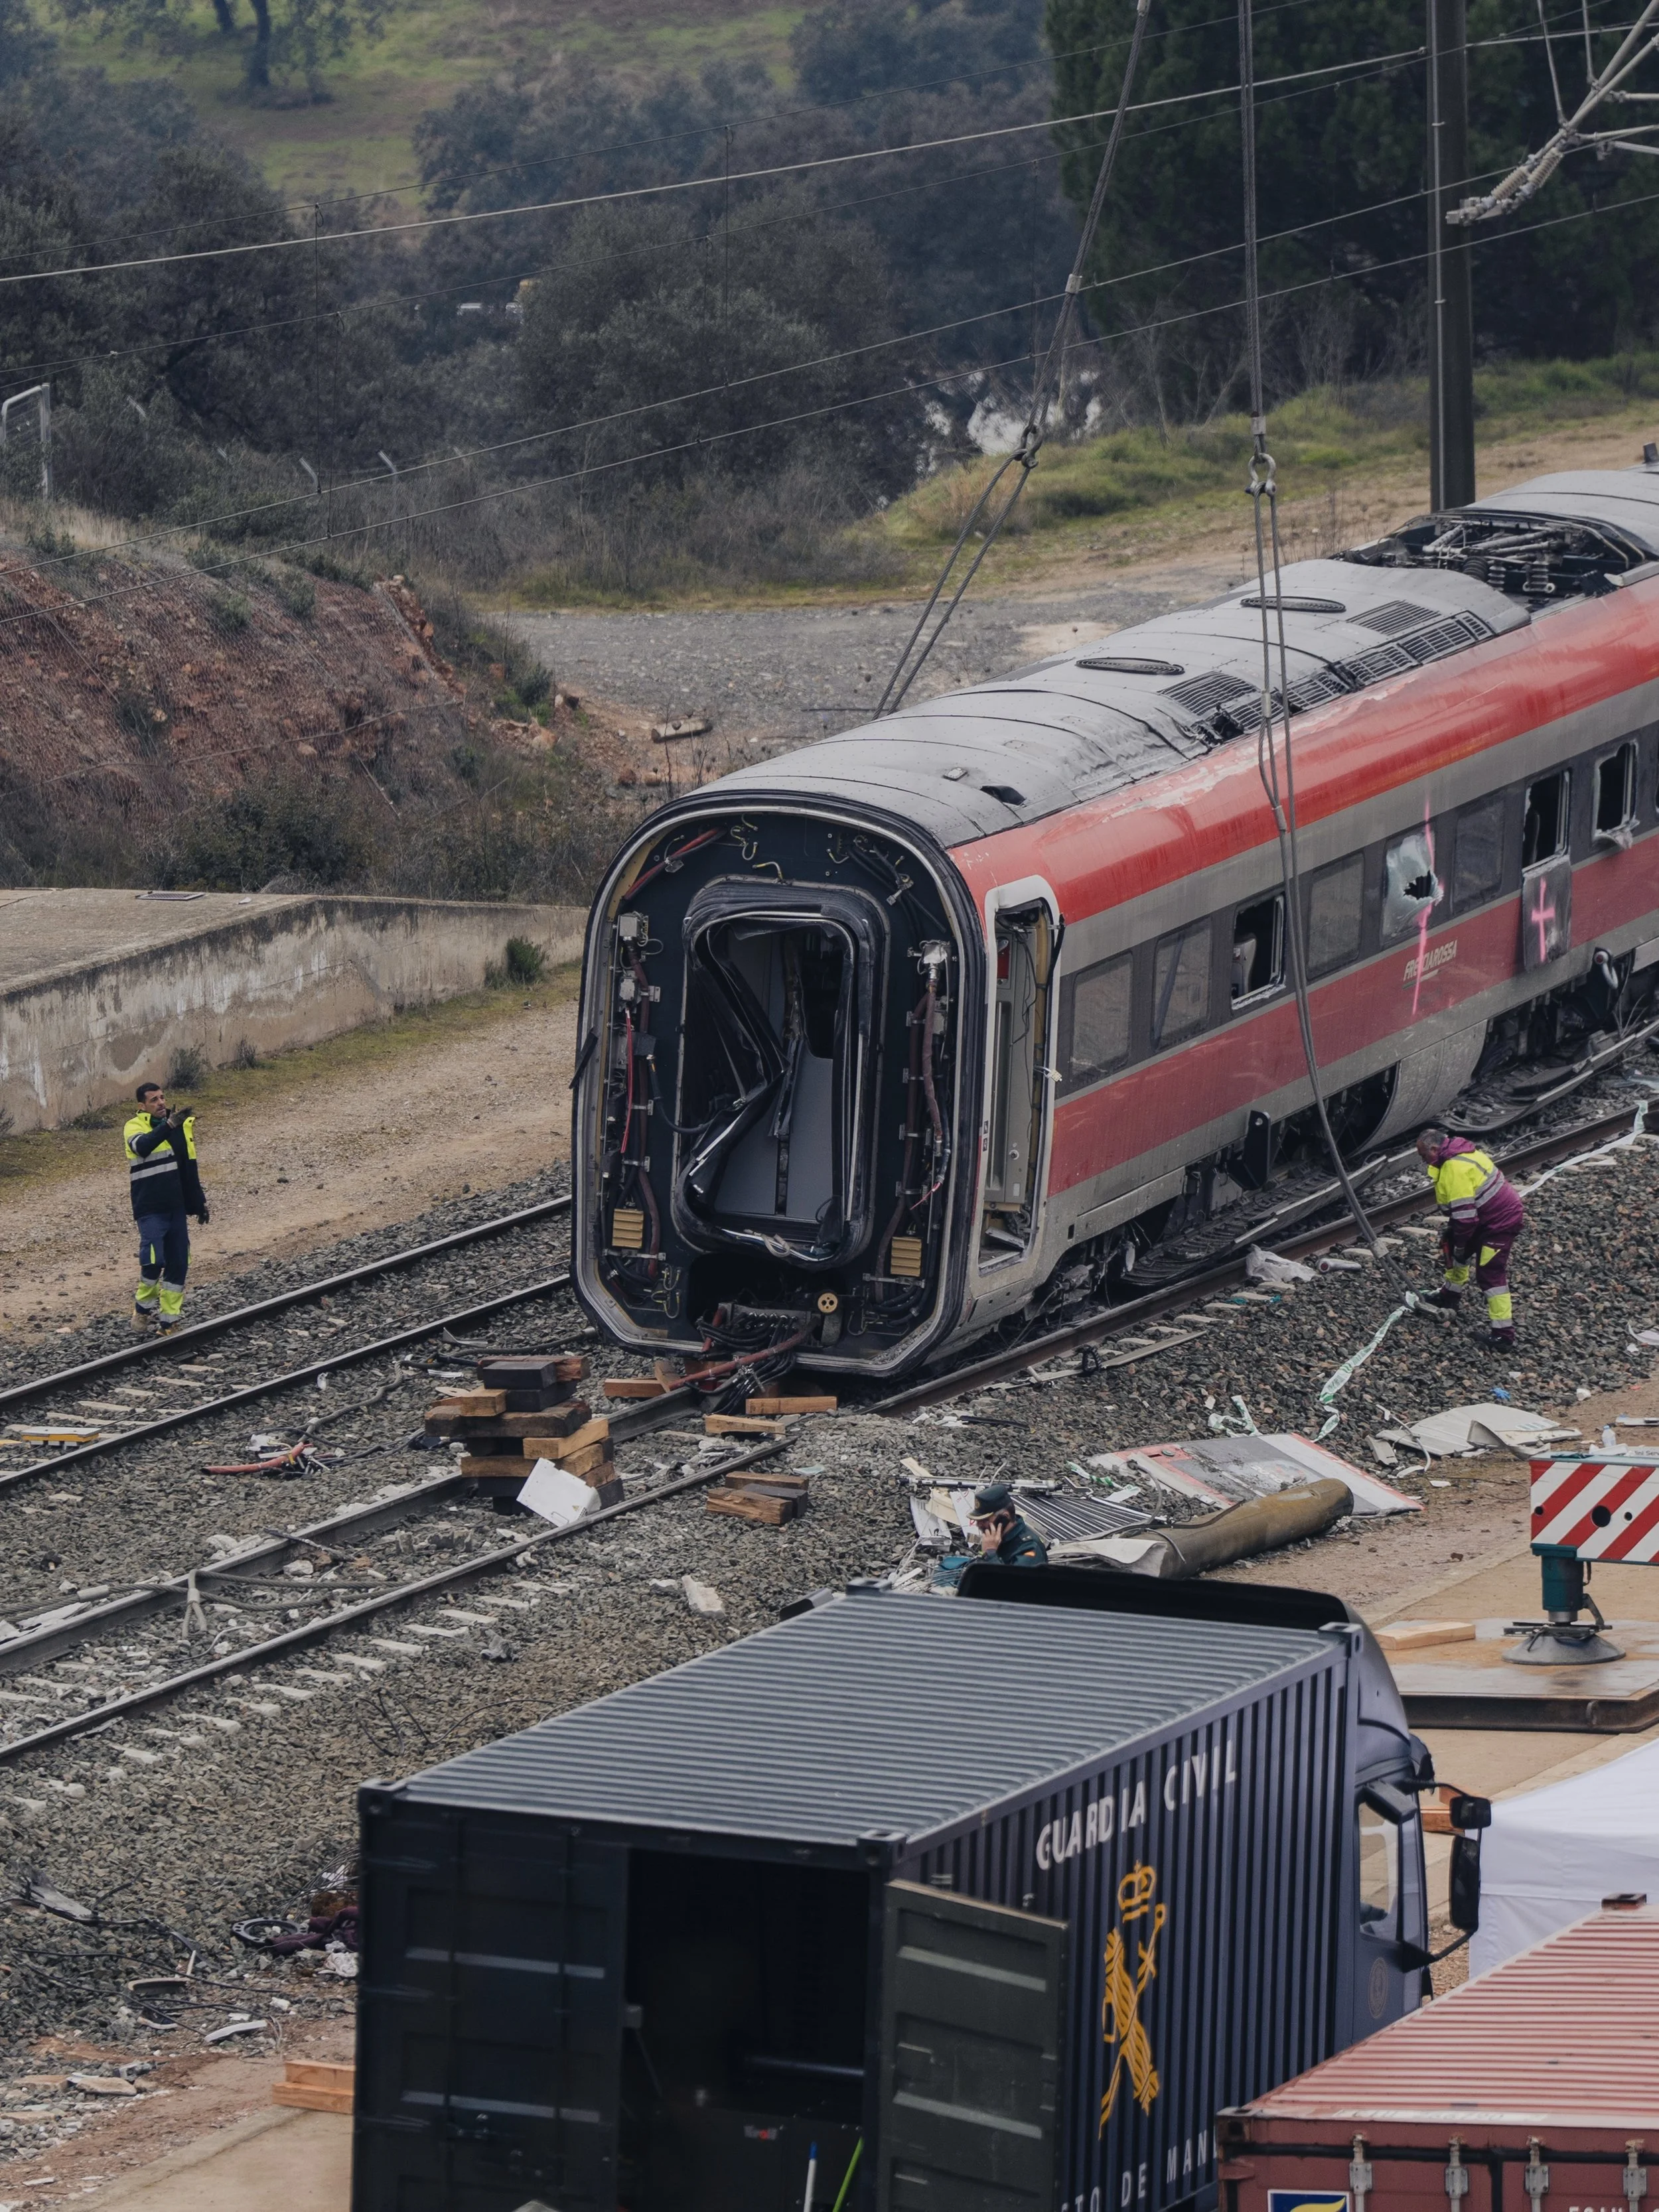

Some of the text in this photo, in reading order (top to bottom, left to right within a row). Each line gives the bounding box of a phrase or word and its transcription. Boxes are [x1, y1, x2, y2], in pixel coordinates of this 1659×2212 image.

[1403, 939, 1457, 981] FRECIAROSSA
[1037, 1740, 1236, 1870] GUARDIA CIVIL
[1121, 2162, 1147, 2207] DE
[1167, 2125, 1218, 2184] MAN
